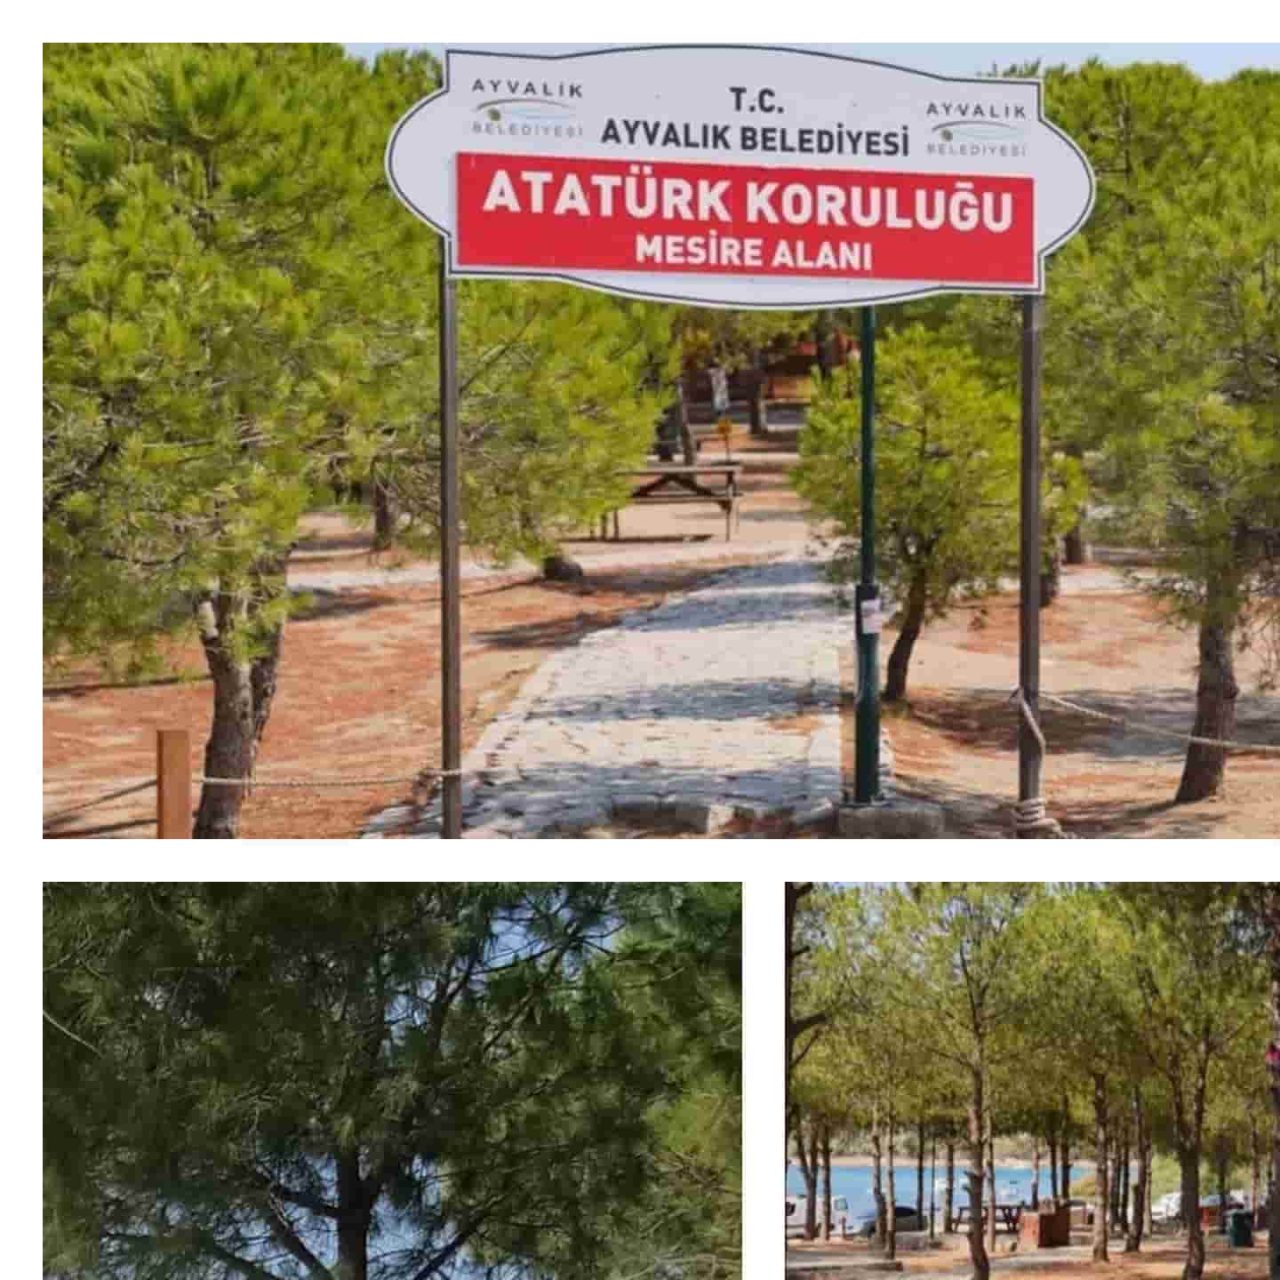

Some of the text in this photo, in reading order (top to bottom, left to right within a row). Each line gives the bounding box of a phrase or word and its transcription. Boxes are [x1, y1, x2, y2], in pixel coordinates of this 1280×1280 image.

[729, 86, 785, 113] T.C.
[601, 118, 909, 157] AYVALIK BELEDİYESİ
[483, 166, 1013, 232] ATATÜRK KORULUĞU
[635, 230, 872, 271] MESİRE ALANI
